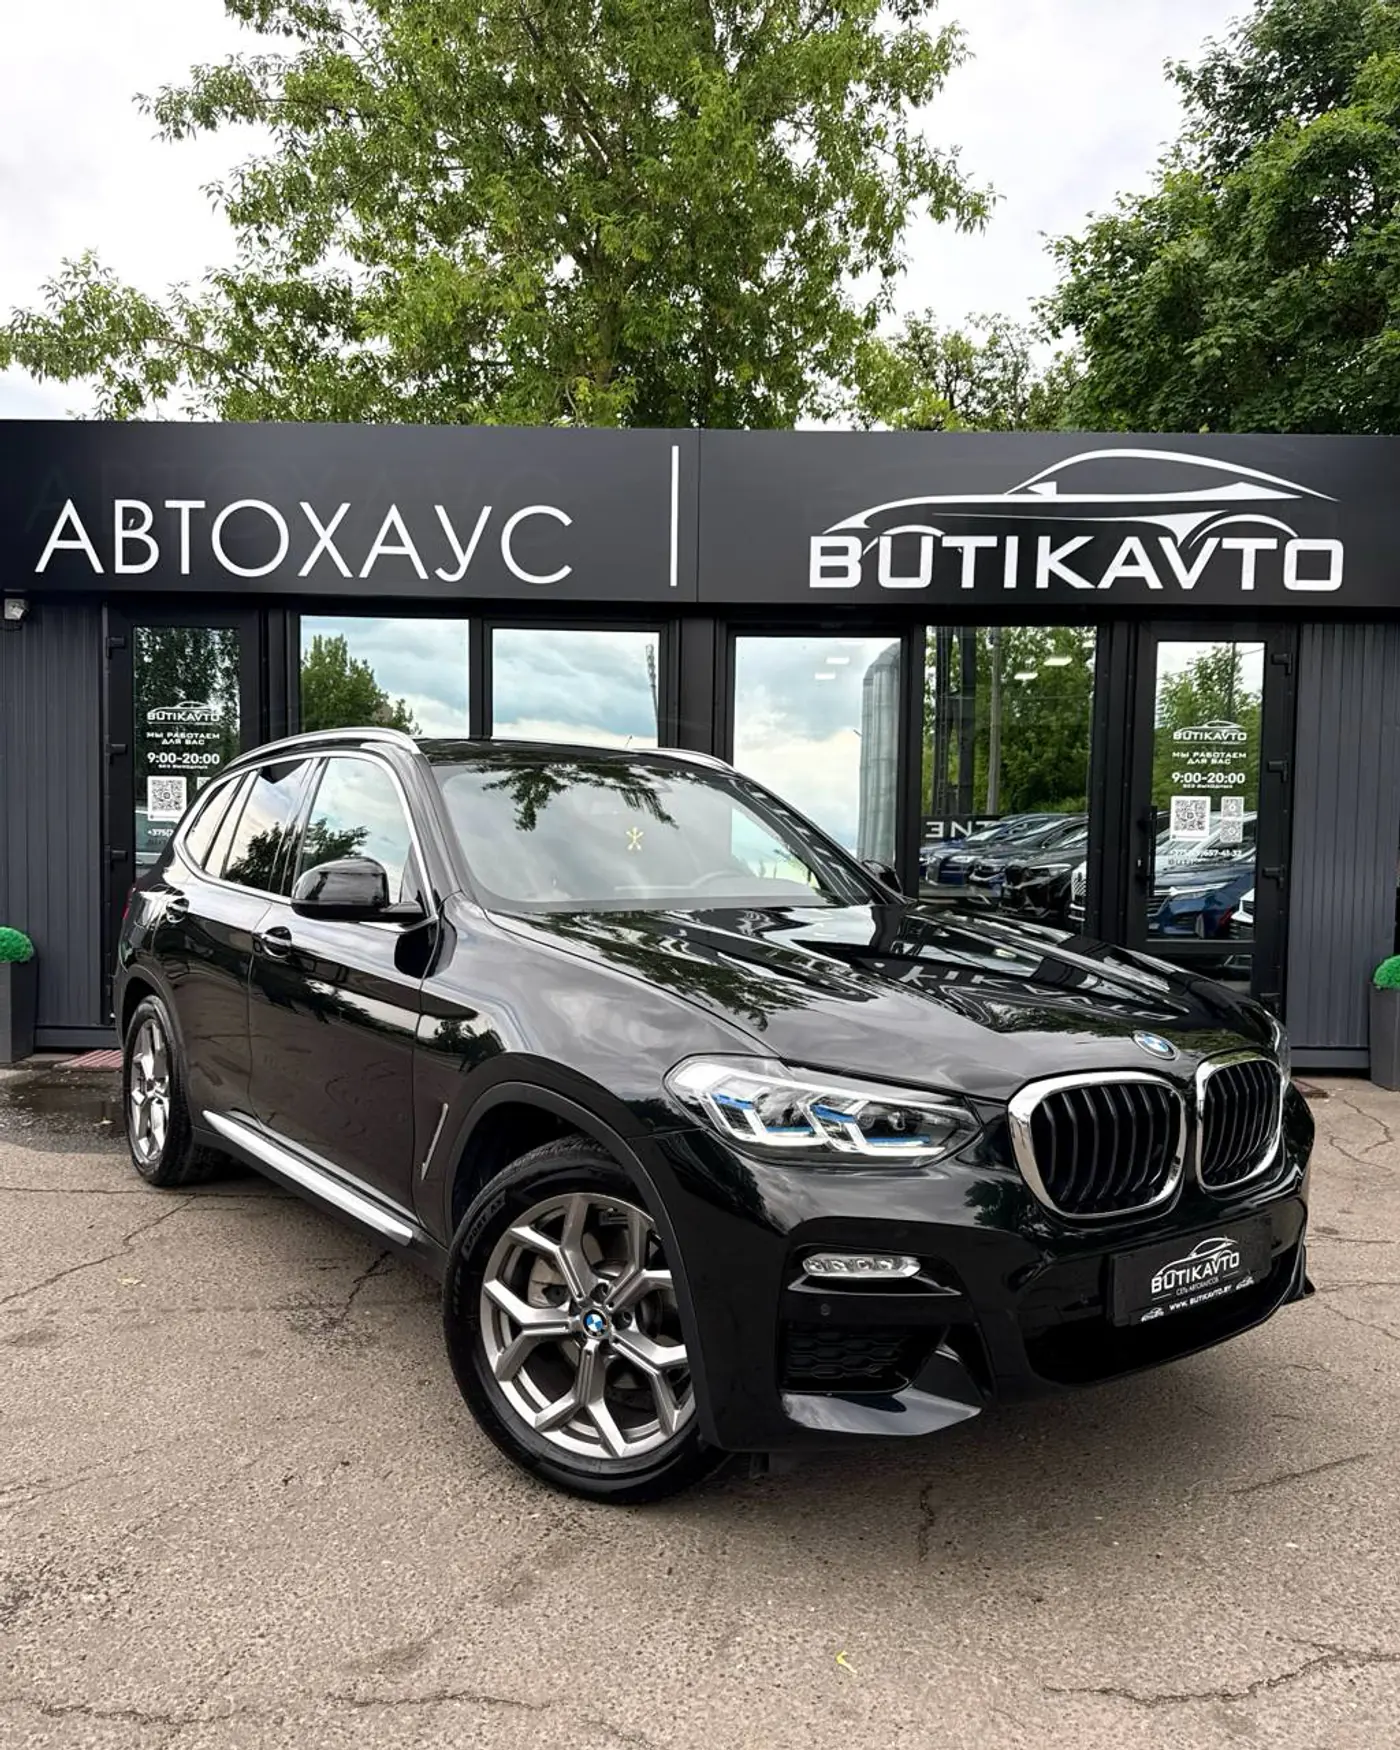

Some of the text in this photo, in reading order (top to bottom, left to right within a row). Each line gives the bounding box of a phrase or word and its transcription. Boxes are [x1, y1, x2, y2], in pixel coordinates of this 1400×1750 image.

[35, 498, 573, 584] АВТОХАУС
[808, 535, 1344, 591] BUTIKAVTO
[147, 712, 220, 722] BUTIKAVTO
[1173, 731, 1247, 741] BUTIKAVTO
[147, 753, 220, 764] 9:00-20:00
[1172, 773, 1246, 784] 9:00-20:00
[1151, 1251, 1240, 1294] BUTIKAVTO
